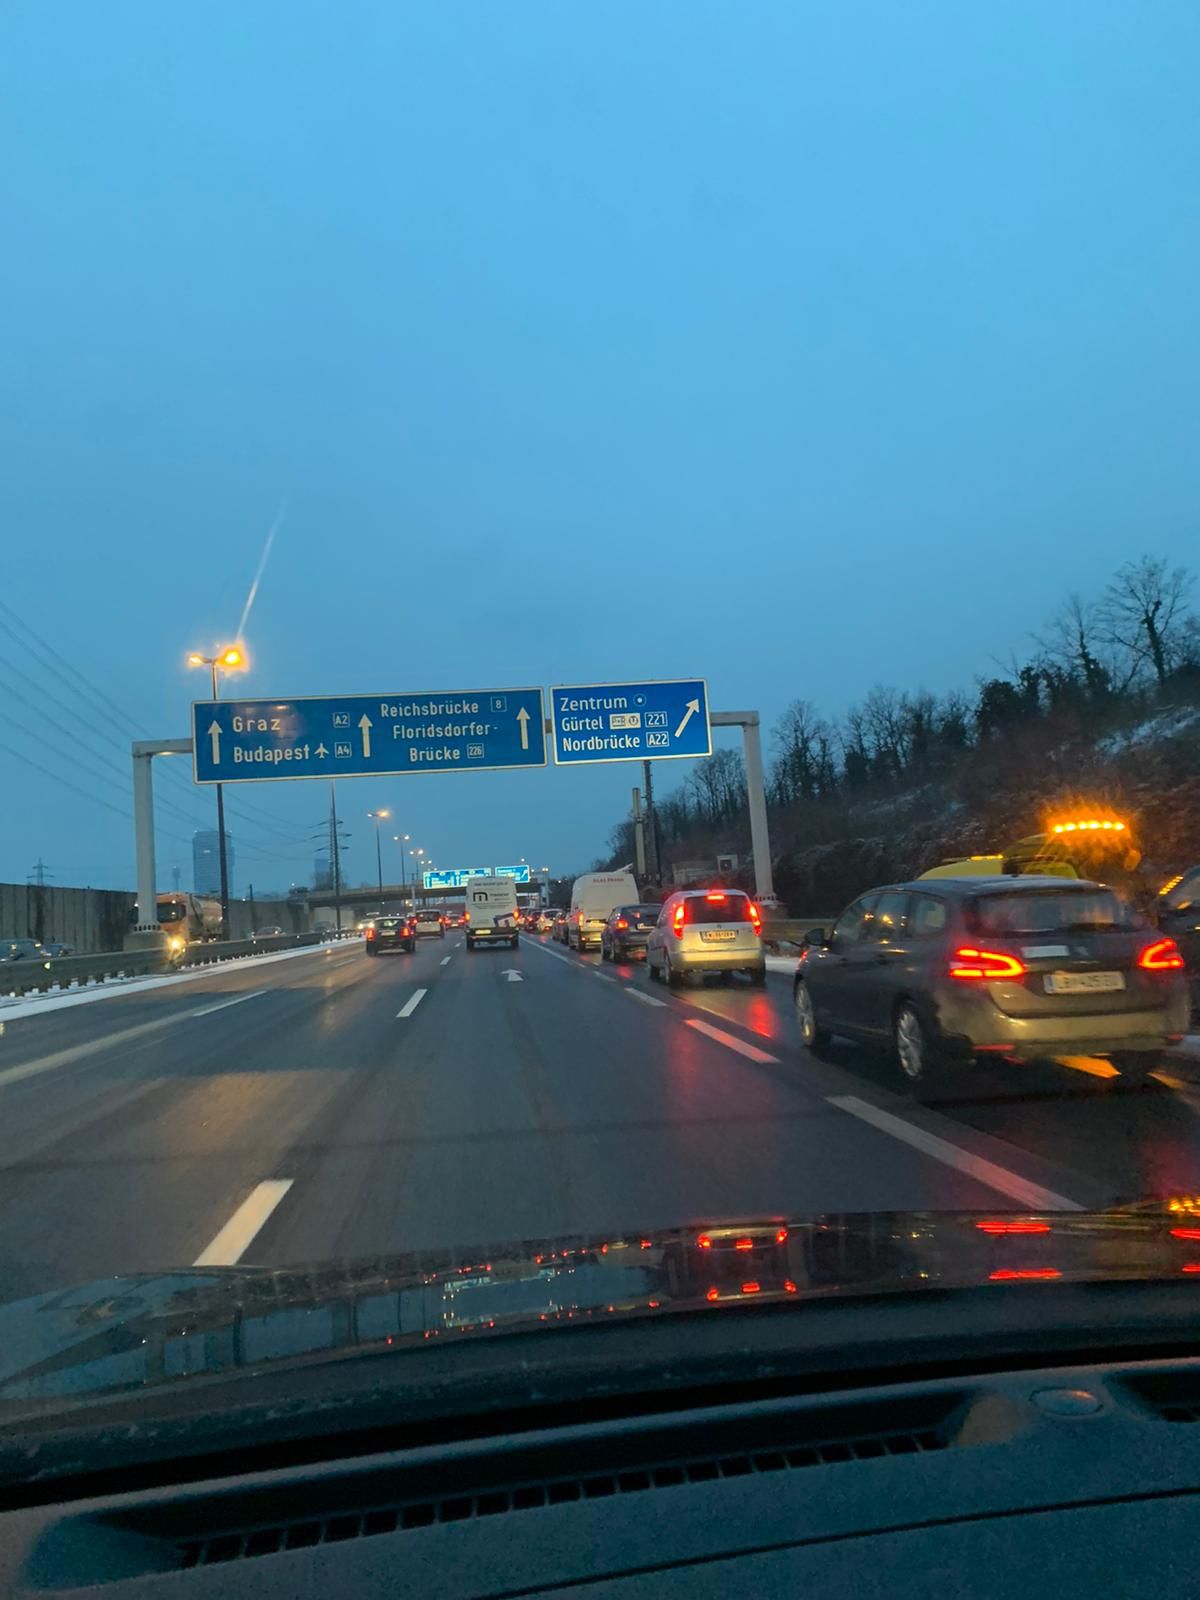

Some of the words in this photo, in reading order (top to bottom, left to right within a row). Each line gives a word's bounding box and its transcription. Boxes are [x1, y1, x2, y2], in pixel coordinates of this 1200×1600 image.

[380, 700, 479, 718] Reichsbrücke
[495, 700, 502, 709] 8
[560, 696, 628, 712] Zentrum
[232, 716, 281, 733] Graz
[335, 715, 348, 725] A2
[561, 715, 604, 732] Gürtel
[647, 714, 665, 725] 221
[562, 734, 641, 752] Nordbrücke
[649, 733, 667, 745] A22
[233, 744, 310, 765] Budapest
[336, 745, 350, 755] A4
[409, 746, 461, 762] Brücke
[468, 745, 482, 756] 226
